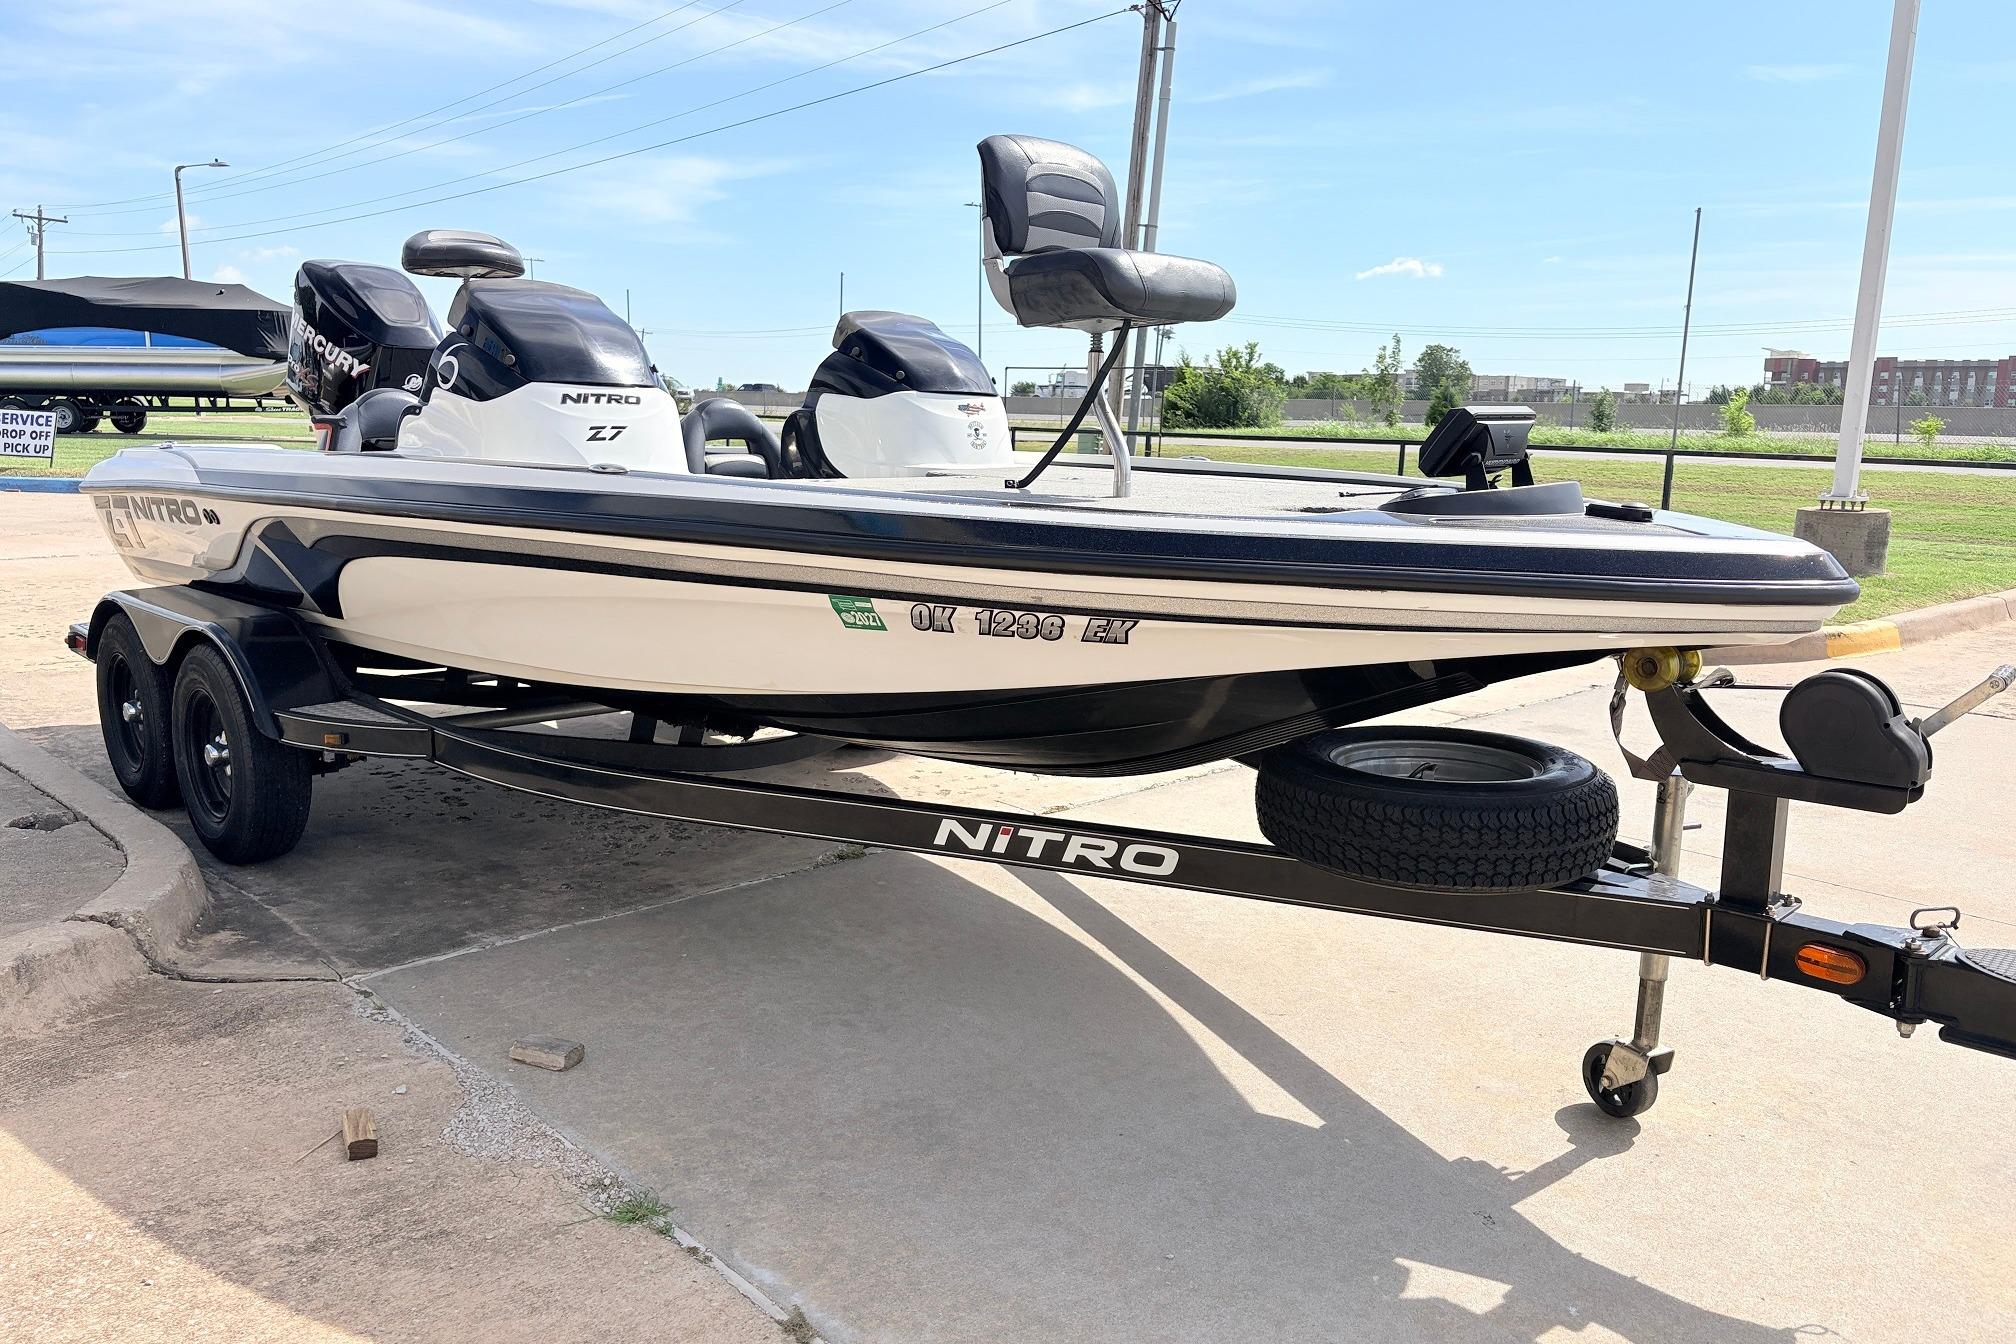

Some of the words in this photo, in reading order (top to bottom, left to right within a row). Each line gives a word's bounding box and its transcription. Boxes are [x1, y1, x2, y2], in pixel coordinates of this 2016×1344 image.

[560, 392, 641, 405] NITRO
[0, 412, 53, 427] ERVICE
[29, 430, 51, 441] OFF
[586, 425, 628, 442] Z7
[3, 442, 31, 454] PICK
[33, 444, 50, 455] UP
[130, 495, 203, 526] NITRO
[850, 611, 882, 626] 2027
[911, 603, 957, 634] OK
[975, 609, 1066, 641] 1236
[1081, 617, 1140, 645] EK
